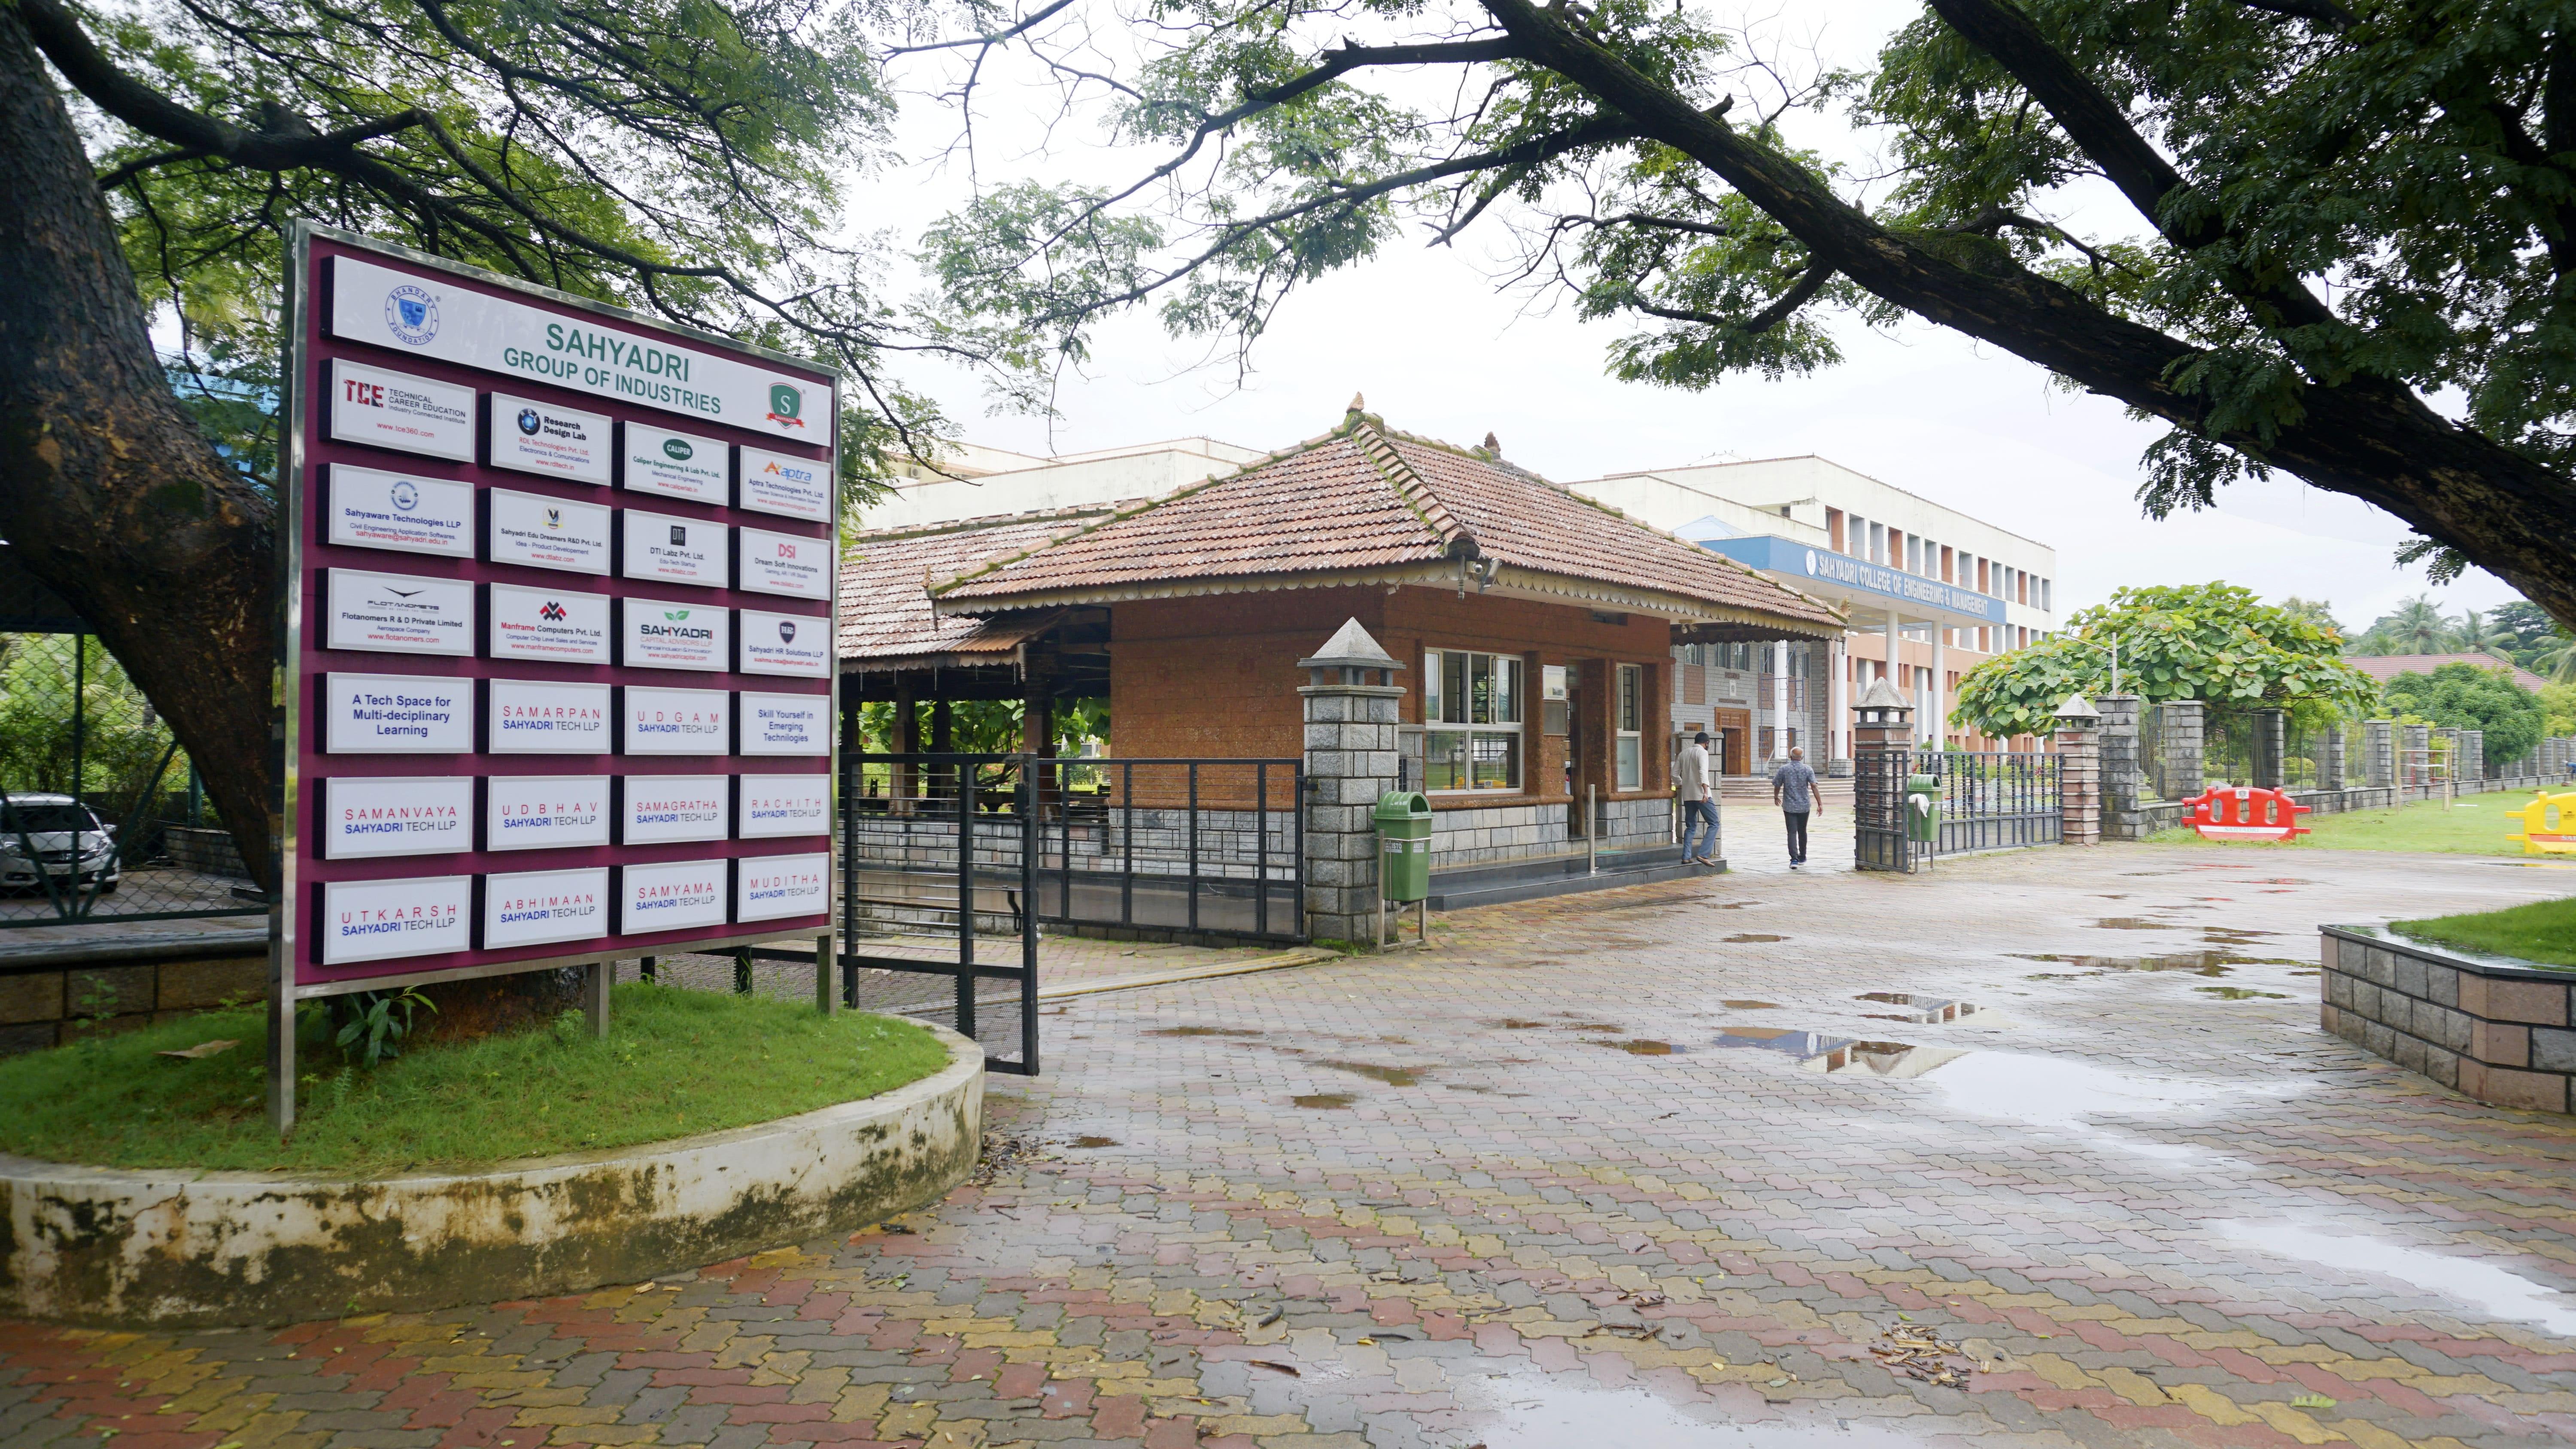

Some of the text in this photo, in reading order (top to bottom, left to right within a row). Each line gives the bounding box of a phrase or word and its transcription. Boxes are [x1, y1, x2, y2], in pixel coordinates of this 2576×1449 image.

[391, 287, 435, 309] BHANDARY
[390, 322, 434, 343] FOUNDATION
[546, 324, 689, 382] SAHYADRI
[504, 348, 721, 414] GROUP OF INDUSTRIES
[343, 379, 384, 408] TCE
[389, 388, 432, 403] TECHNICAL
[389, 397, 465, 417] CAREER EDUCATION
[389, 405, 465, 424] Industry Connected Institute
[544, 416, 580, 430] Research
[377, 423, 434, 438] www.tce360.com
[544, 426, 586, 440] Design Lab
[519, 446, 547, 455] Electronics
[532, 440, 566, 451] Technologies
[667, 445, 690, 455] CALIPER
[633, 456, 652, 465] Caliper
[653, 460, 683, 472] Engineering
[652, 470, 703, 485] Mechanical Engineering
[766, 482, 801, 494] Technologies
[345, 508, 389, 520] Sahyaware
[393, 514, 444, 527] Technologies
[364, 524, 396, 534] Engineering
[398, 529, 427, 537] Application
[501, 528, 526, 537] Sahyadri
[540, 534, 566, 542] Dreamers
[553, 546, 589, 555] Developement
[778, 543, 796, 558] DSI
[787, 563, 817, 573] Innovations
[1819, 555, 1988, 616] SAHYADRI COLLEGE OF ENGINEERING & MANAGEMENT
[368, 600, 439, 610] FLOTANOMERS
[342, 612, 387, 622] Flotanomers
[501, 622, 535, 631] Manframe
[537, 625, 573, 635] Computers
[641, 625, 712, 639] SAHYADRI
[781, 626, 794, 634] HR
[368, 634, 439, 643] www.flotanomers.com
[749, 646, 773, 654] Sahyadri
[352, 694, 451, 708] A Tech Space for
[353, 709, 450, 723] Multi-deciplinary
[503, 706, 600, 719] SAMARPAN
[638, 711, 718, 723] UDGAM
[759, 709, 773, 718] Skill
[776, 710, 805, 719] Yourself
[377, 725, 428, 737] Learning
[503, 720, 599, 731] SAHYADRI TECH LLP
[638, 724, 679, 733] SAHYADRI
[681, 725, 702, 733] TECH
[769, 721, 803, 732] Emerging
[502, 802, 597, 815] UDBHAV
[637, 800, 717, 812] SAMAGRATHA
[752, 799, 820, 808] RACHITH
[345, 806, 456, 820] SAMANVAYA
[636, 814, 677, 824] SAHYADRI
[680, 813, 701, 822] TECH
[752, 810, 787, 818] SAHYADRI
[345, 821, 456, 834] SAHYADRI TECH LLP
[504, 815, 596, 828] SAHYADRI TECH LLP
[750, 874, 818, 889] MUDITHA
[638, 882, 713, 899] SAMYAMA
[750, 890, 785, 900] SAHYADRI
[787, 888, 805, 896] TECH
[504, 894, 592, 910] ABHIMAAN
[636, 896, 715, 910] SAHYADRI TECH LLP
[342, 904, 456, 924] UTKARSH
[501, 906, 595, 923] SAHYADRI TECH LLP
[342, 918, 455, 936] SAHYADRI TECH LLP
